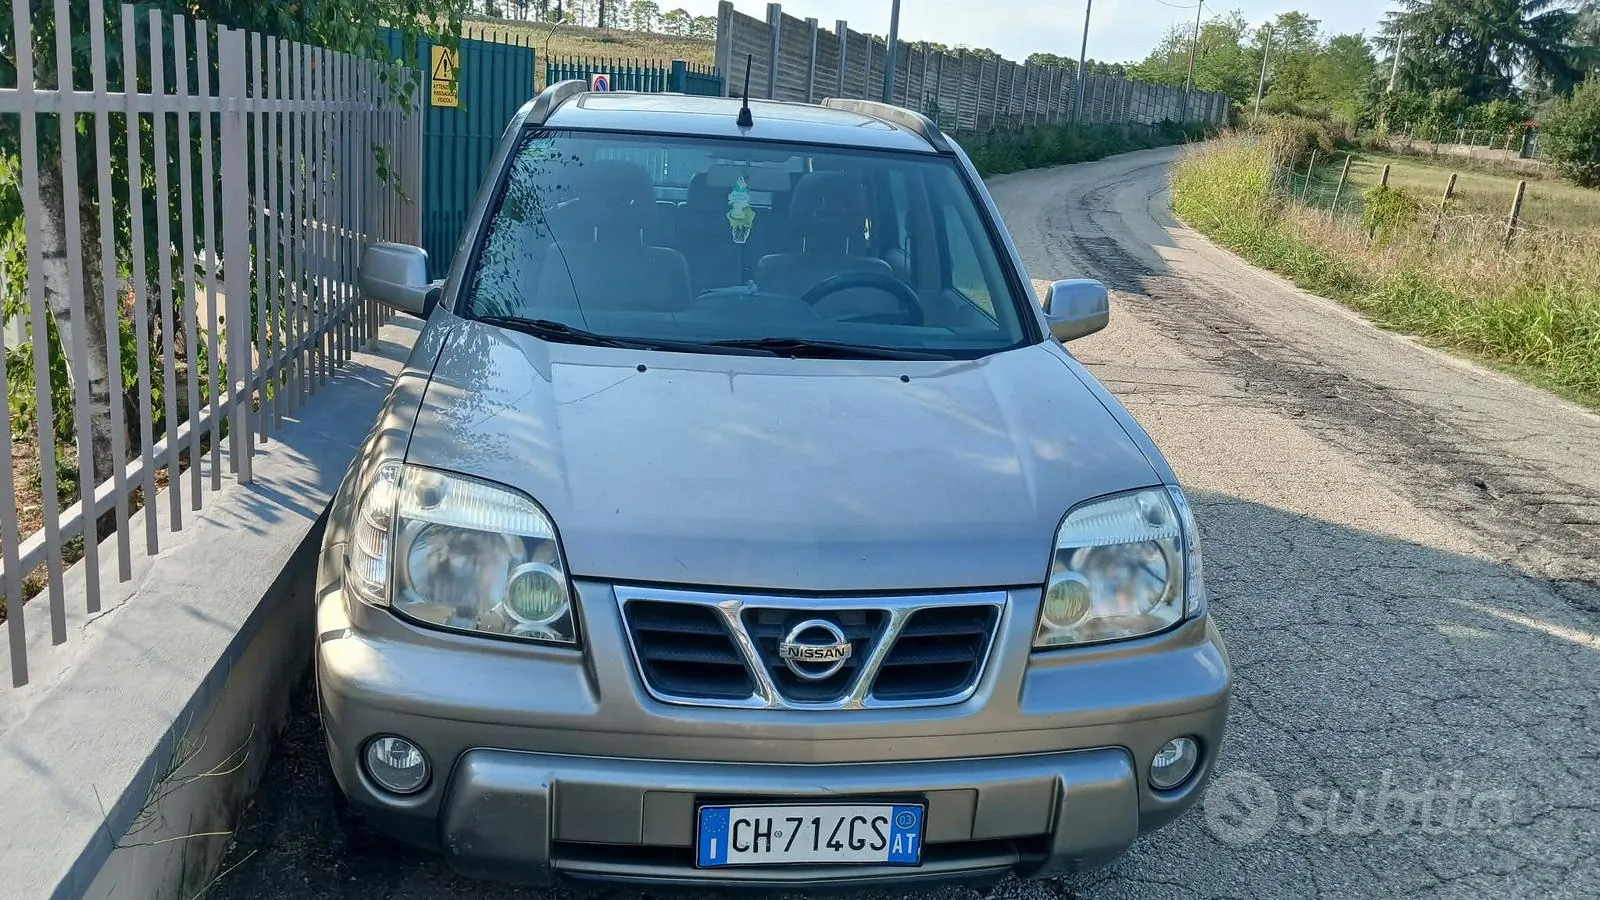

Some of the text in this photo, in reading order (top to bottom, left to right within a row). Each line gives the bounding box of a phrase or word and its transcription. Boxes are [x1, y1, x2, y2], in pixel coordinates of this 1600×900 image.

[788, 647, 845, 659] NISSAN
[899, 816, 912, 825] 03
[892, 833, 916, 854] AT
